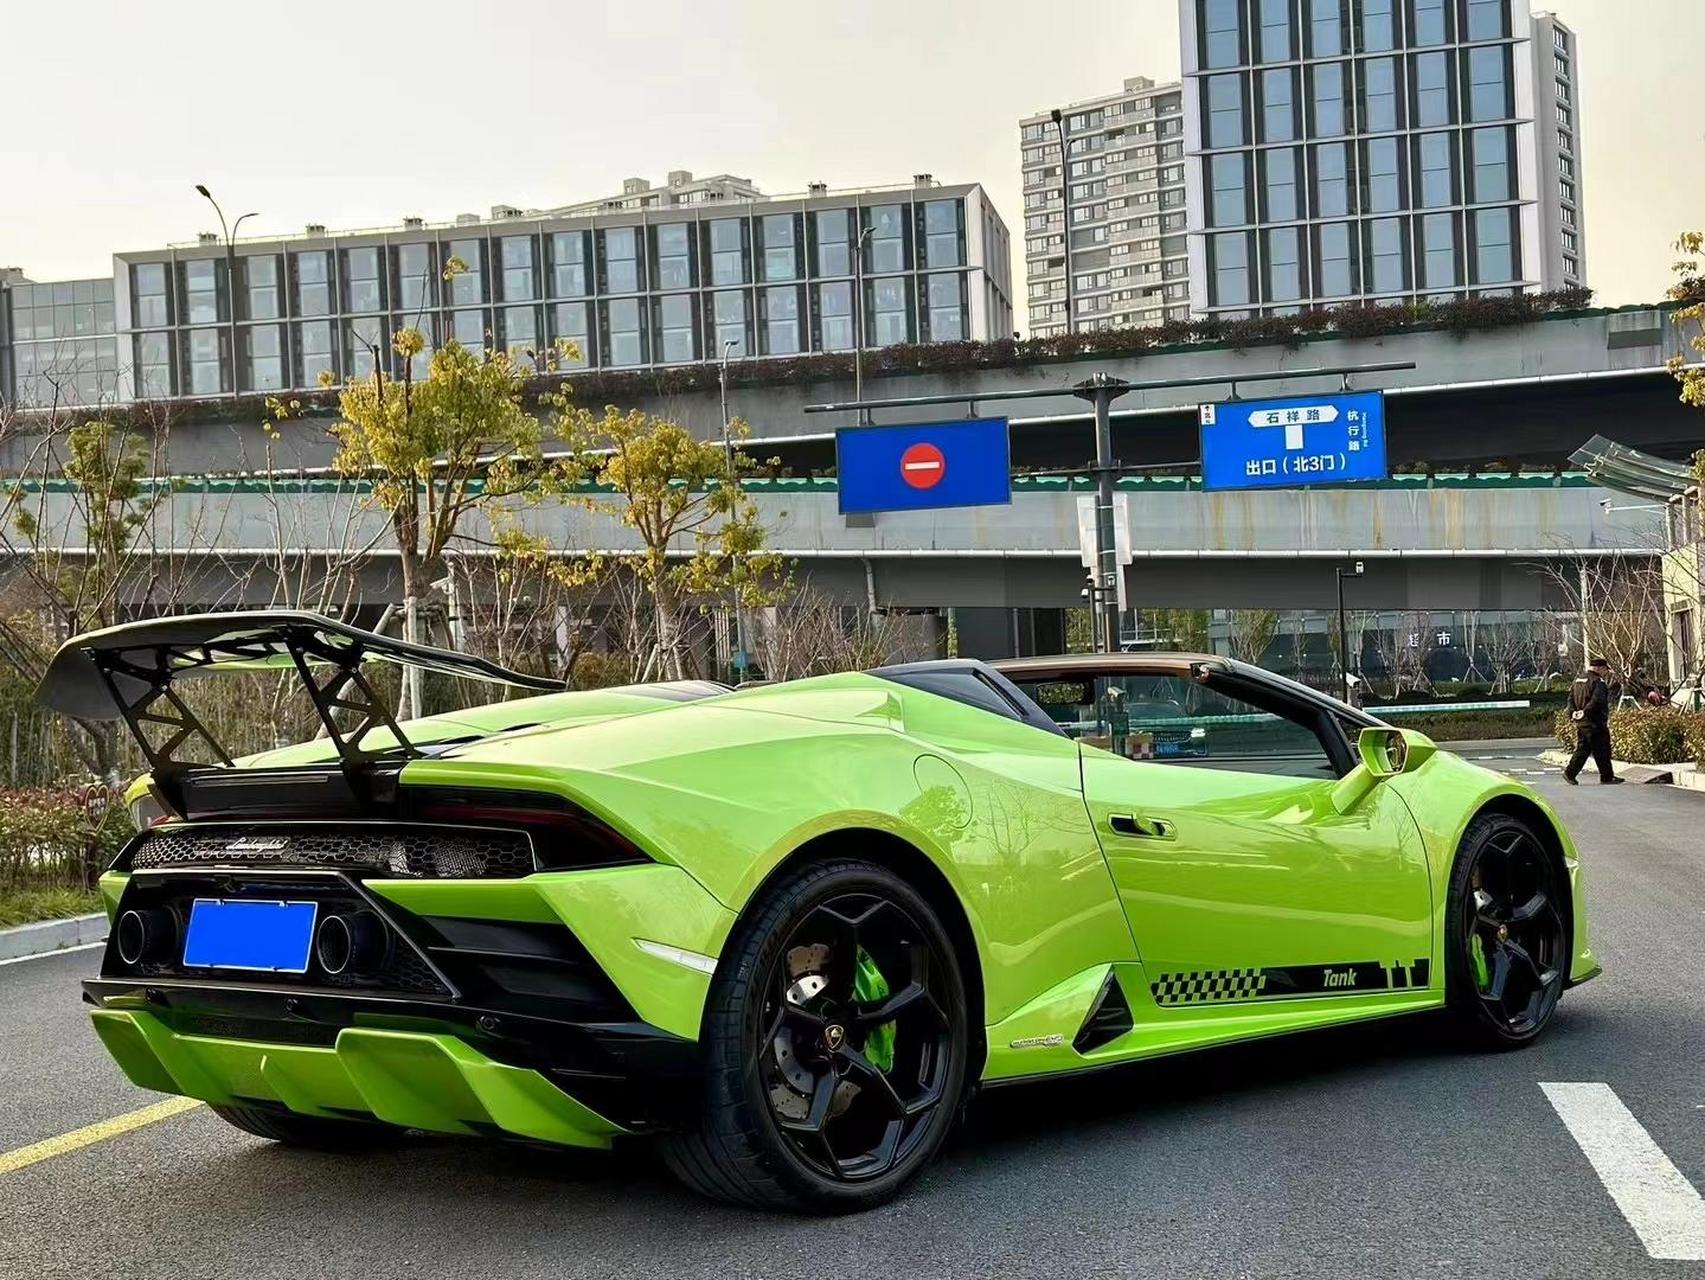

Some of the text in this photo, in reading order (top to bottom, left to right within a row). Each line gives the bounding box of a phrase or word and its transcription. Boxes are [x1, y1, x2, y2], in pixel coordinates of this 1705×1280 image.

[1266, 409, 1320, 424] 石祥路
[1323, 967, 1358, 987] Tank
